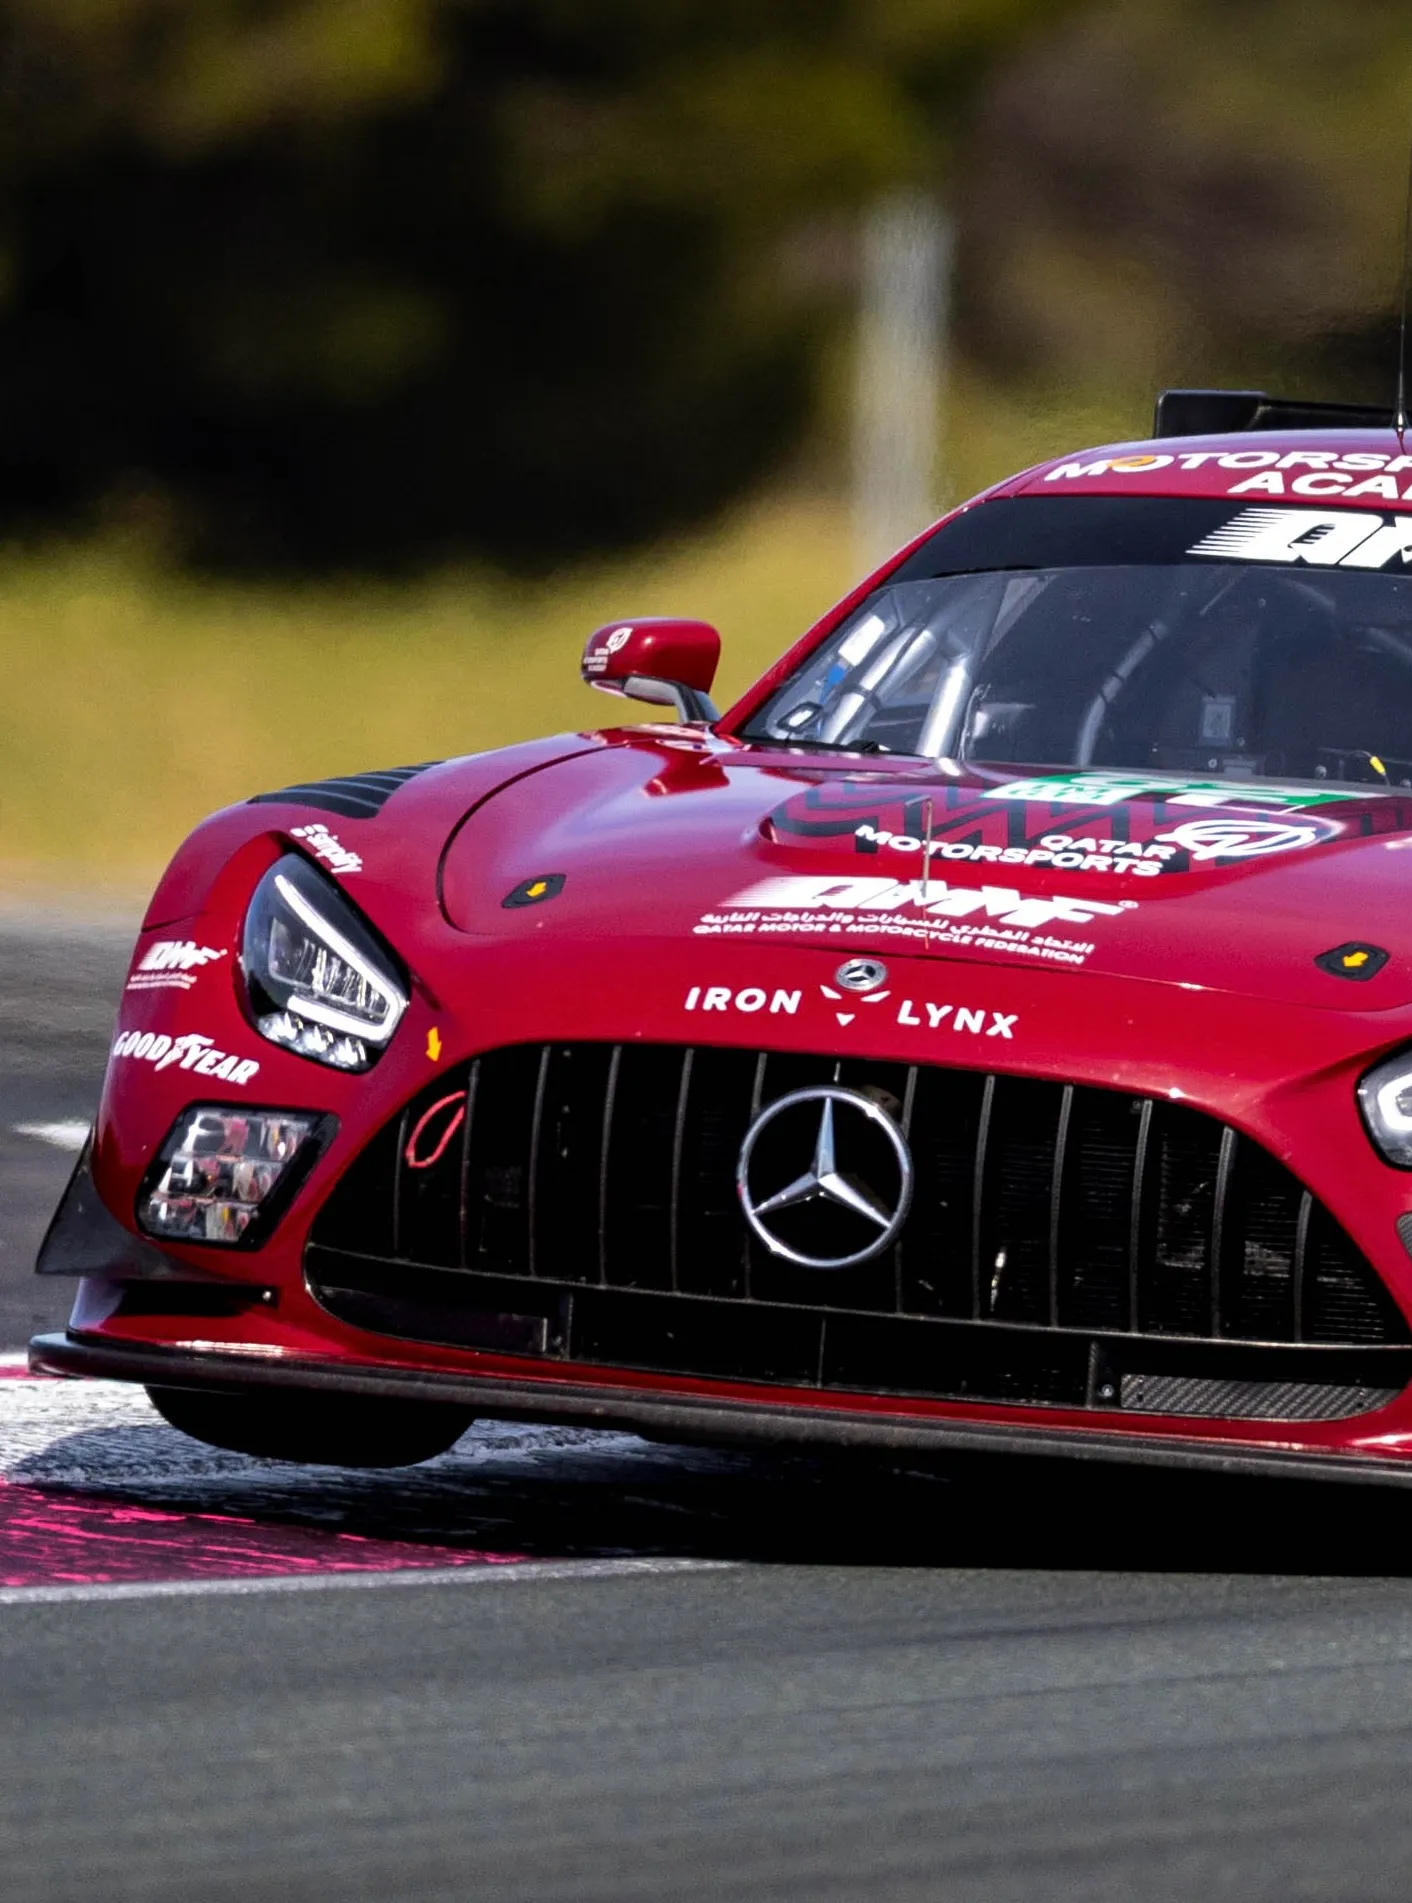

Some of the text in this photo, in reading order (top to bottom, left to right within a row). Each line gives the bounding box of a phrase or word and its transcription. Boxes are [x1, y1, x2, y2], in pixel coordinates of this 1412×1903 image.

[855, 824, 1163, 876] MOTORSPORTS
[1041, 834, 1177, 860] QATAR
[692, 923, 1085, 964] QATAR MOTOR & MOTORCYCLE FEDERATION
[684, 986, 1018, 1040] IRON LYNX
[112, 1030, 260, 1085] GOODYEAR
